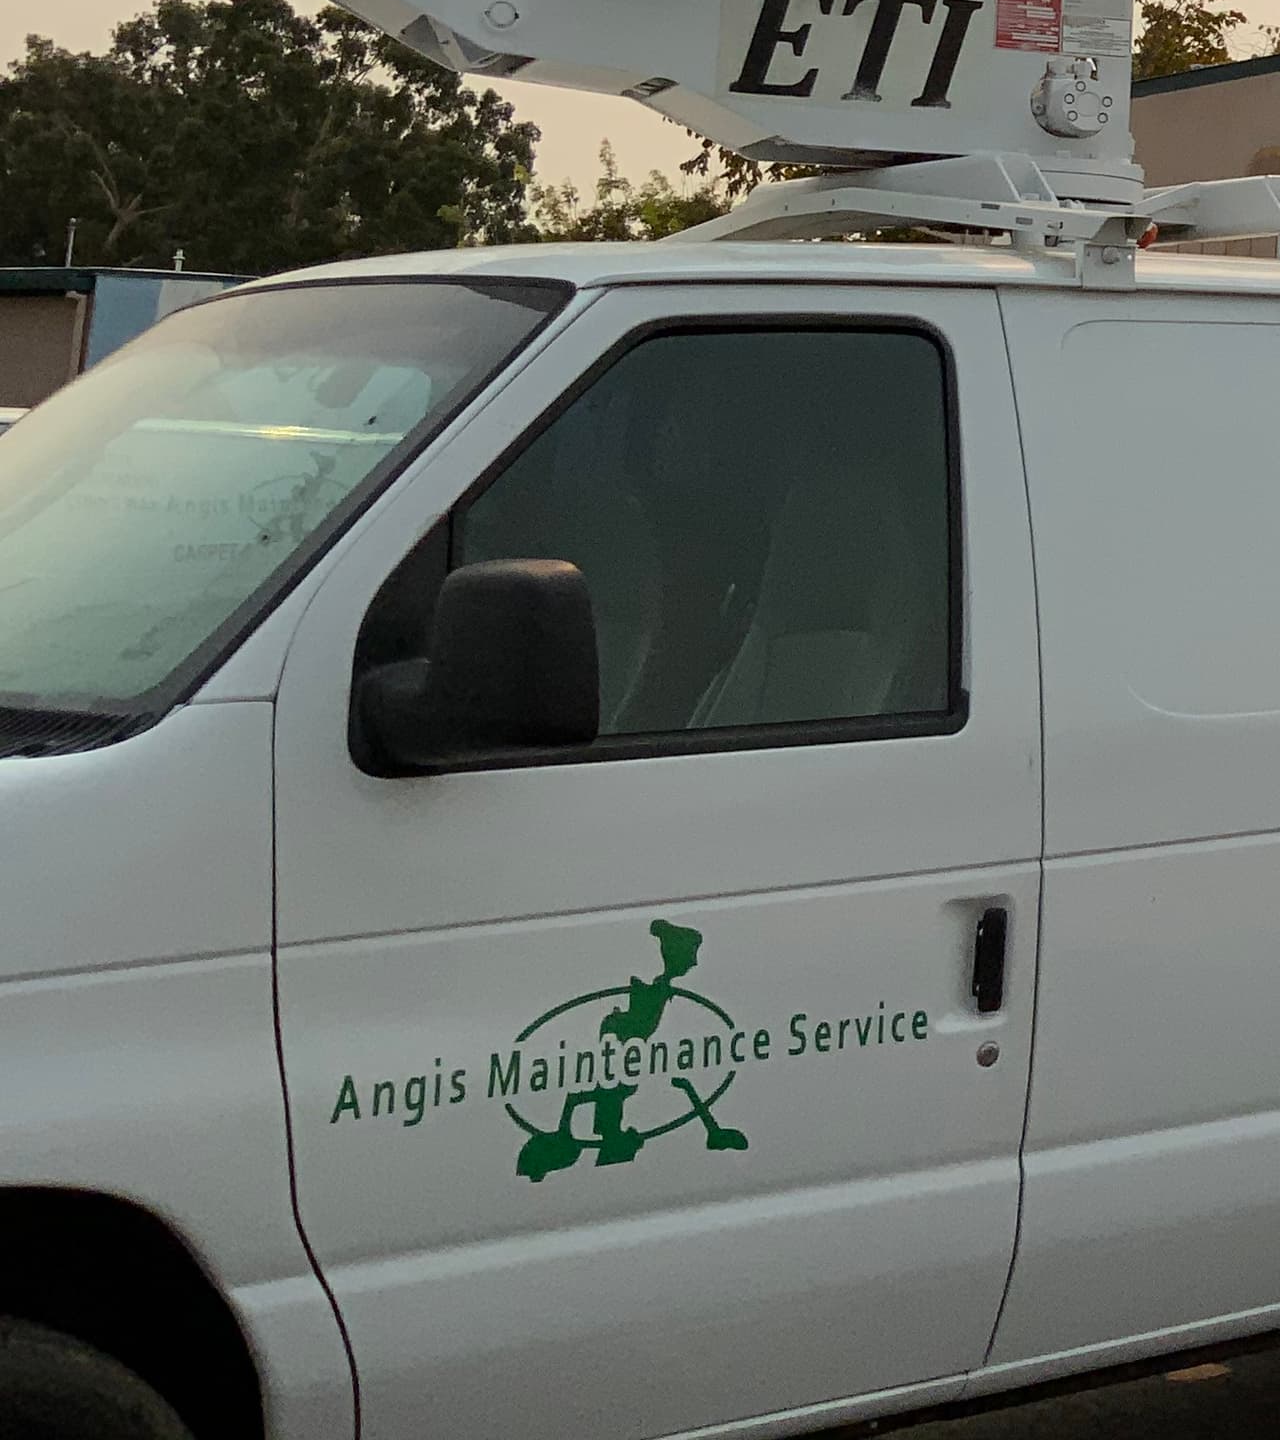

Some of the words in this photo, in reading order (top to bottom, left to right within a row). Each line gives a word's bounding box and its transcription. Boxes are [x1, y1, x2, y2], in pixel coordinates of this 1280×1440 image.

[330, 1057, 467, 1128] Angis
[487, 1024, 771, 1099] Maintenance
[787, 1001, 930, 1057] Service
